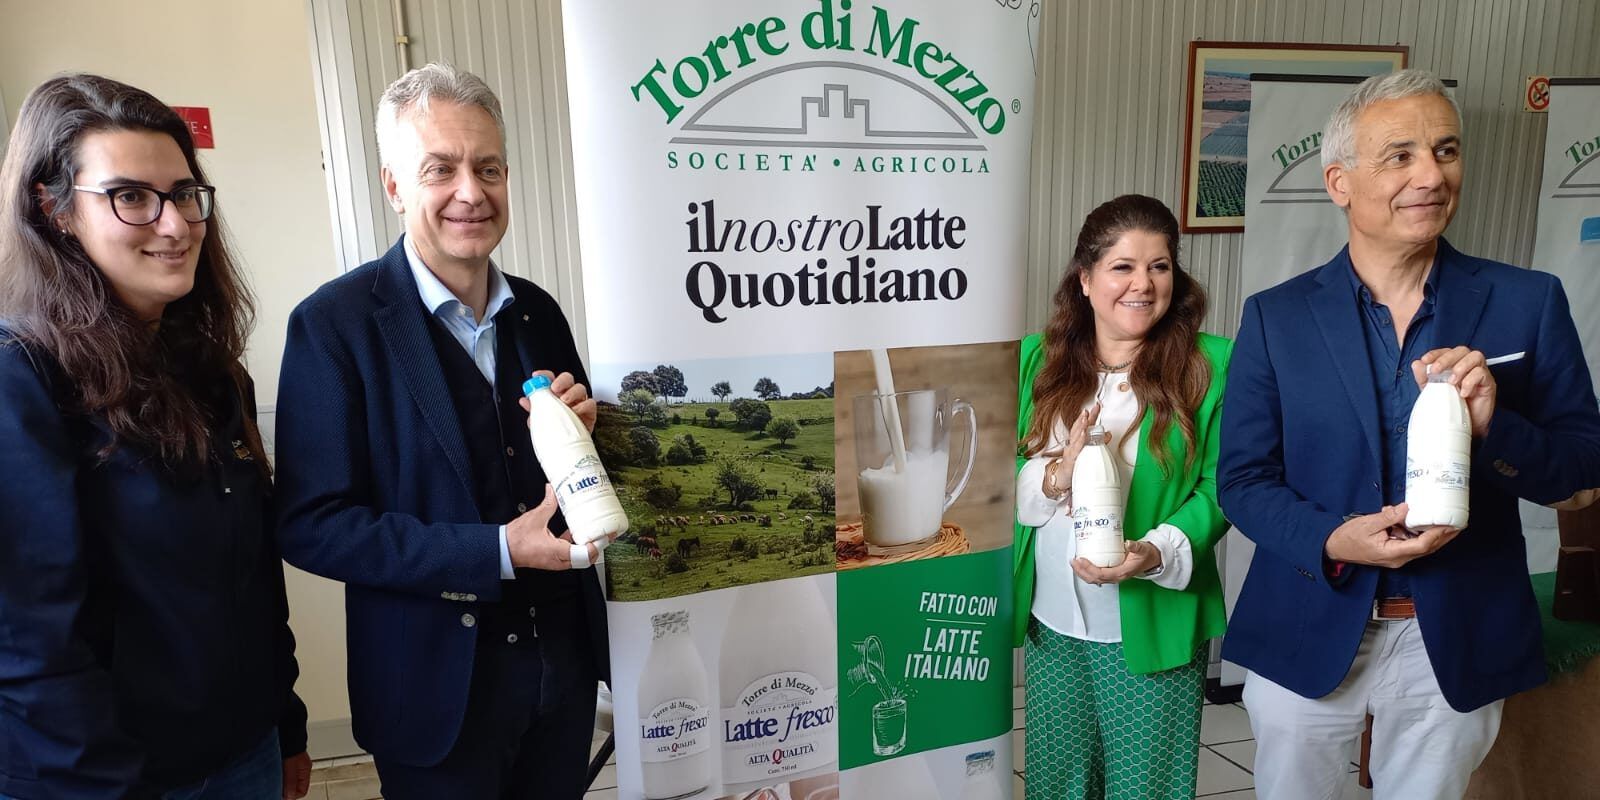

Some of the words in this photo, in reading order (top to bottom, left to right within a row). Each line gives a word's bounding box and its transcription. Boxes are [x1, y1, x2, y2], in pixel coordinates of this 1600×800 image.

[631, 16, 789, 124] Torre
[800, 0, 855, 52] di
[863, 5, 1006, 136] Mezzo
[854, 155, 991, 174] AGRICOLA
[685, 255, 969, 324] Quotidiano
[567, 475, 600, 494] Latte
[919, 591, 967, 615] FATTO
[967, 595, 998, 617] CON
[923, 626, 983, 655] LATTE
[904, 653, 990, 682] ITALIANO
[741, 685, 768, 708] Torre
[770, 678, 782, 690] di
[785, 677, 815, 696] Mezzo
[641, 724, 675, 739] Latte
[675, 717, 708, 740] fresco
[724, 716, 779, 743] Latte
[778, 705, 834, 743] fresco
[748, 753, 770, 765] ALTA
[771, 743, 814, 765] QUALITÀ
